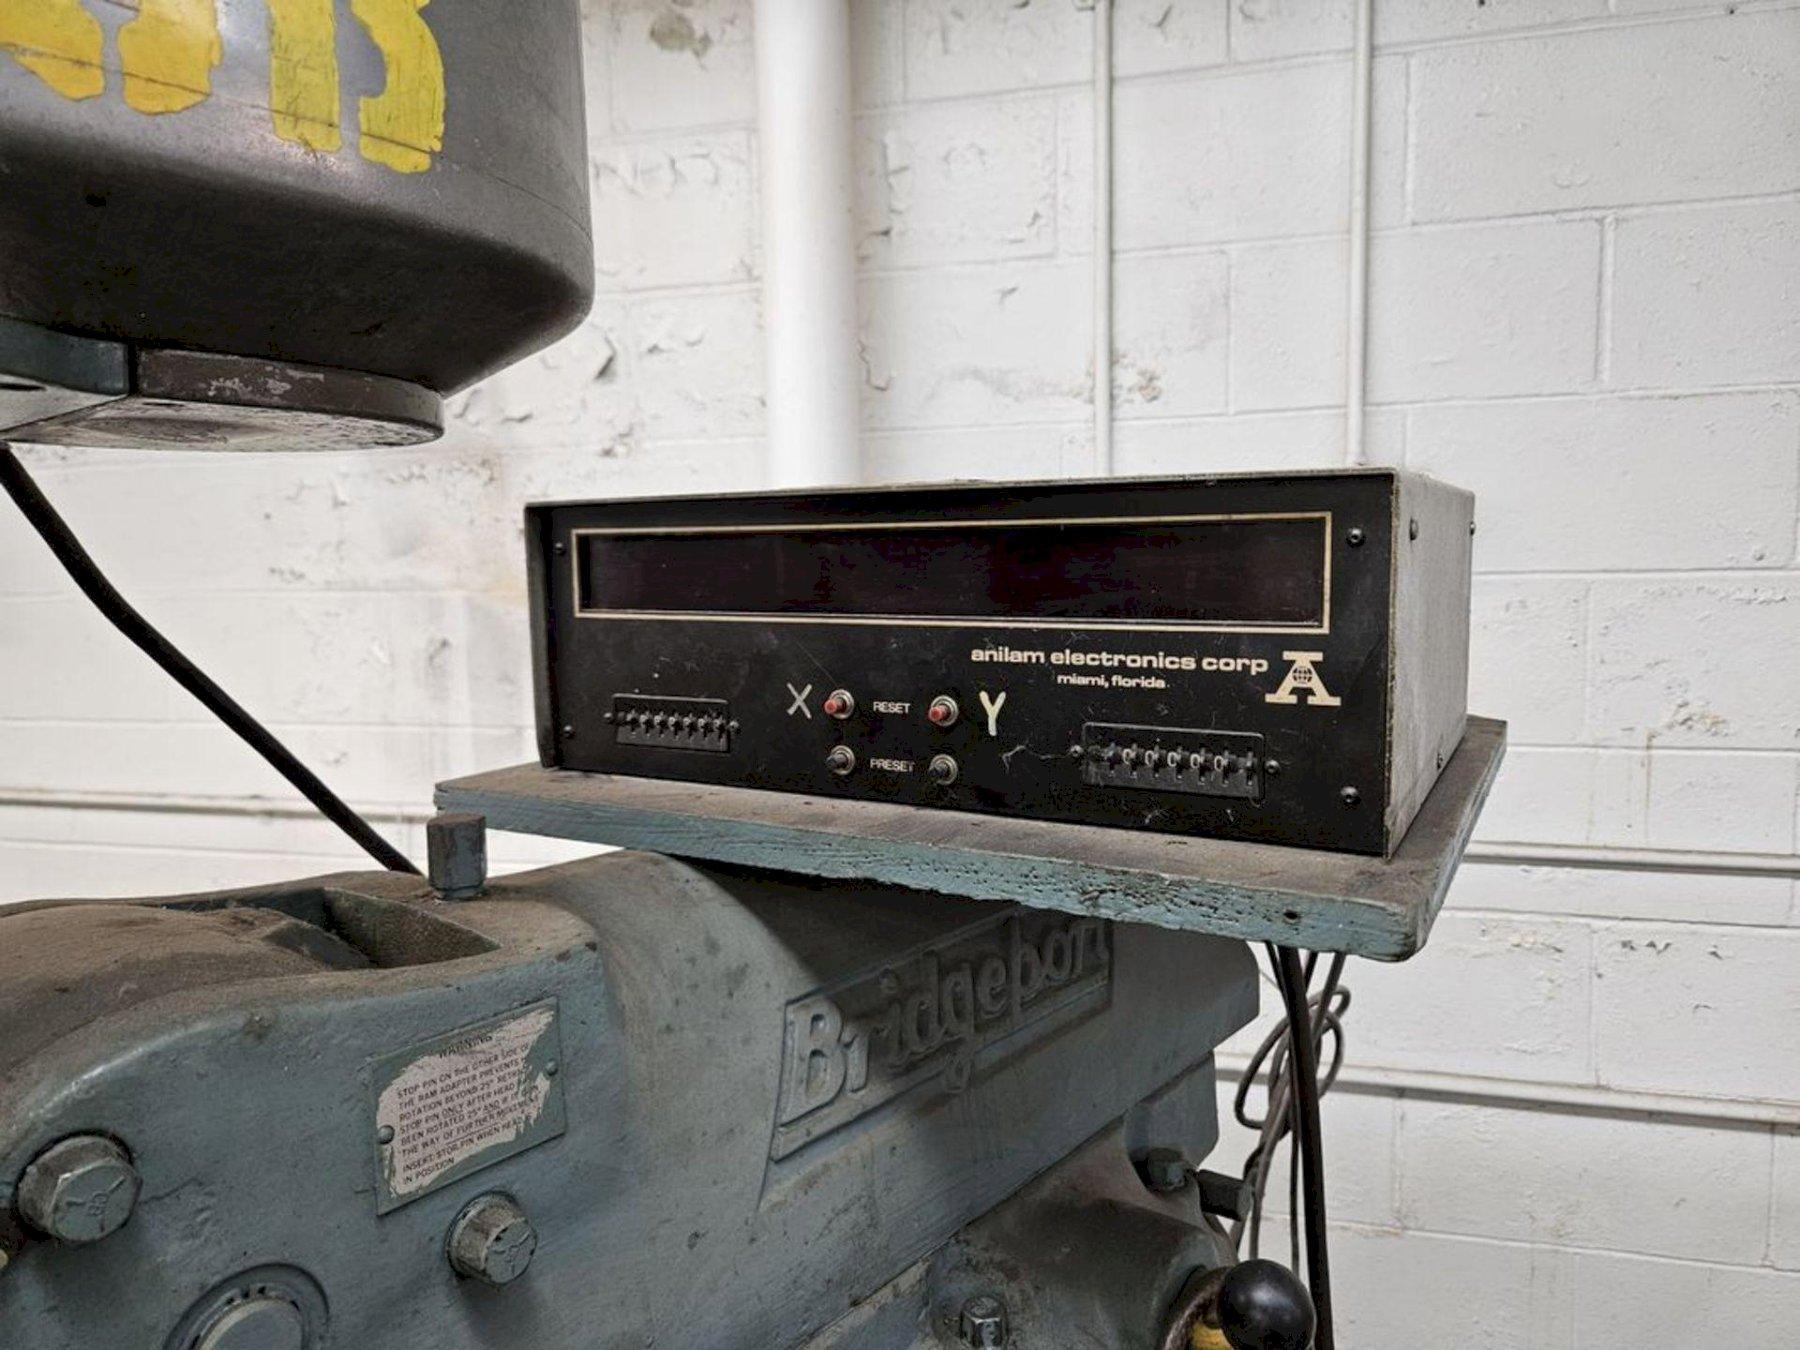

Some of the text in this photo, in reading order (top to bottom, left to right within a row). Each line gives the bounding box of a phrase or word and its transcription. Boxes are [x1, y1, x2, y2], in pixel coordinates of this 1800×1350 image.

[970, 648, 1270, 676] anilam electronics corp
[1057, 673, 1109, 689] miami,
[786, 683, 813, 720] X
[872, 701, 912, 715] RESET
[978, 690, 1007, 737] Y
[869, 757, 915, 773] PRESET
[778, 912, 1111, 1127] Bridgeport
[398, 1083, 419, 1099] STOP
[423, 1076, 437, 1089] PIN
[439, 1071, 451, 1083] ON
[454, 1064, 468, 1077] THE
[471, 1053, 497, 1071] OTHER
[398, 1097, 414, 1111] THE
[418, 1088, 437, 1103] RAM
[440, 1073, 476, 1094] ADAPTER
[479, 1056, 519, 1079] PREVENTS
[399, 1097, 441, 1123] ROTATION
[445, 1083, 477, 1104] BEYOND
[399, 1118, 421, 1135] STOP
[425, 1111, 439, 1124] PIN
[441, 1101, 463, 1118] ONLY
[466, 1090, 491, 1108] AFTER
[493, 1080, 515, 1097] HEAD
[401, 1129, 423, 1146] BEEN
[426, 1112, 464, 1136] ROTATED
[483, 1098, 499, 1112] AND
[402, 1143, 418, 1158] THE
[421, 1134, 439, 1150] WAY
[443, 1128, 453, 1141] OF
[456, 1111, 494, 1135] FURTHER
[402, 1153, 432, 1174] INSERT
[436, 1142, 457, 1160] STOP
[460, 1135, 474, 1149] PIN
[476, 1125, 499, 1142] WHEN
[404, 1156, 453, 1184] IN POSITION
